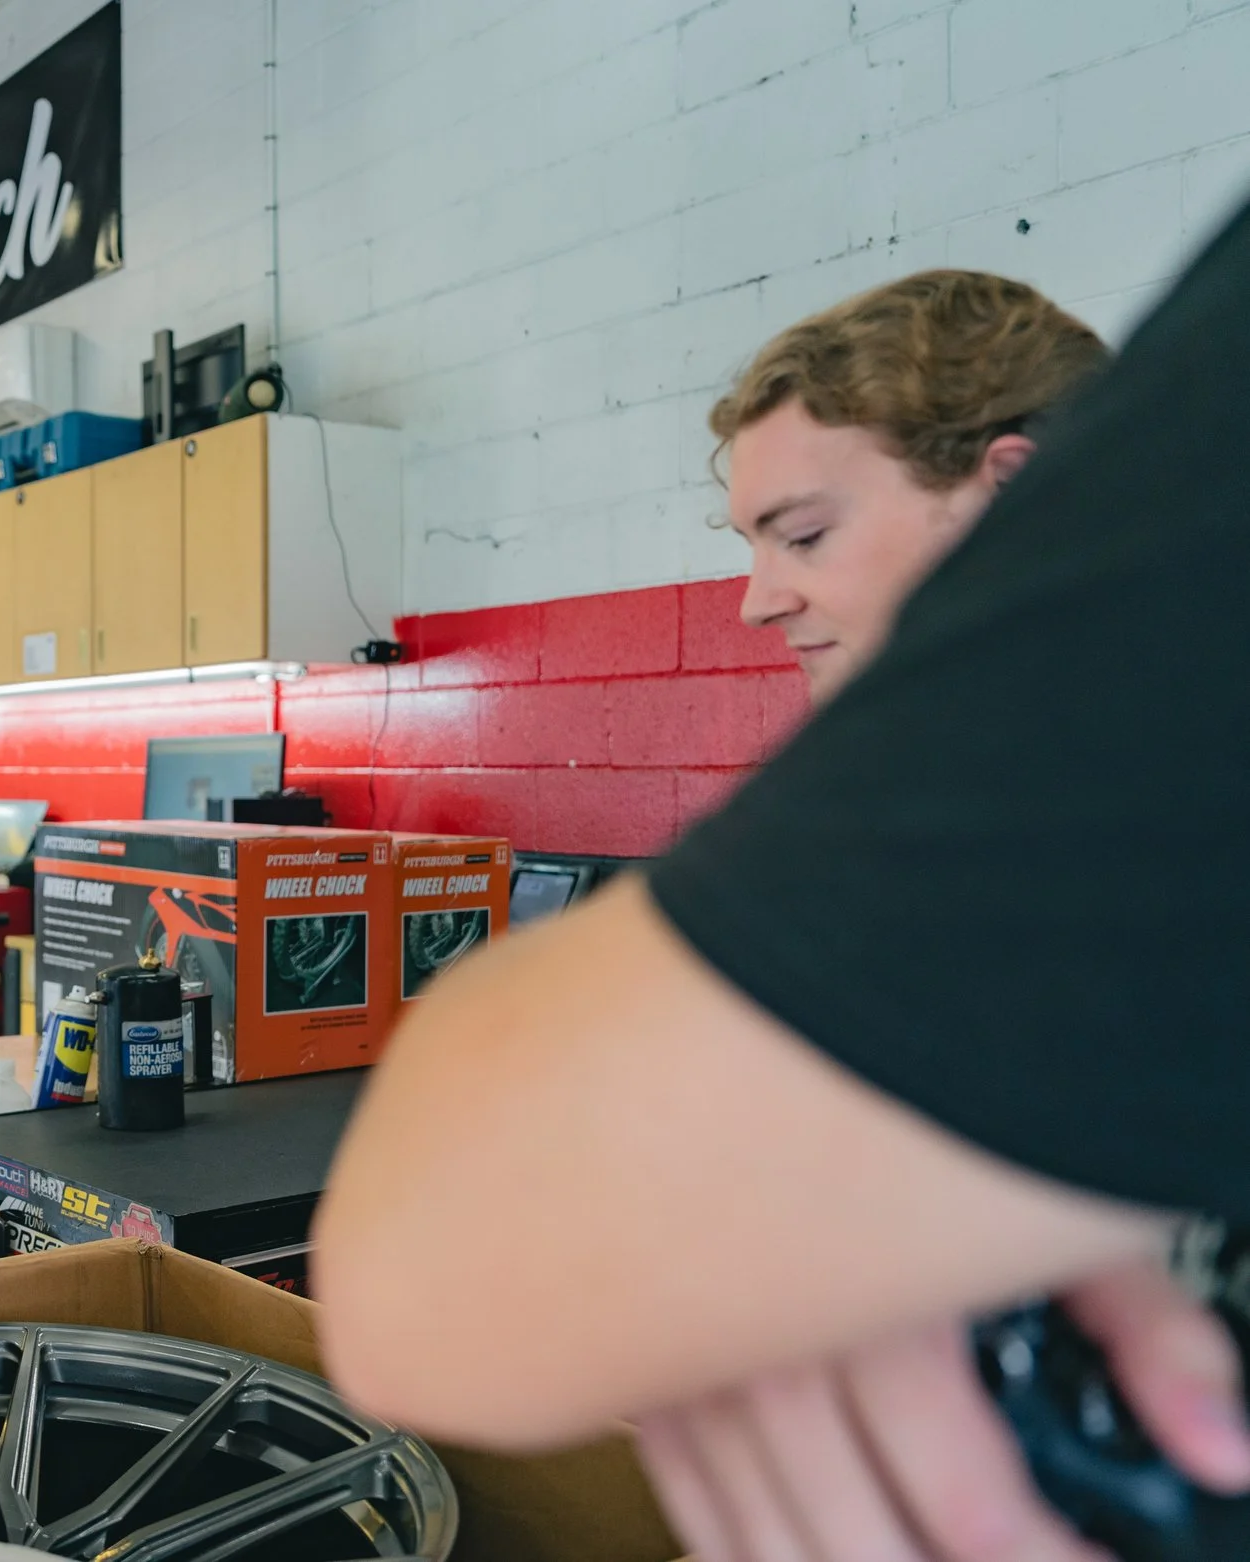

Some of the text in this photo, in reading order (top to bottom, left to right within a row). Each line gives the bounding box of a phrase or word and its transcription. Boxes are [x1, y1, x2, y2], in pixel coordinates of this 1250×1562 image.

[266, 853, 335, 866] PITTSBURGH
[403, 854, 465, 868] PITTSBURGH
[264, 874, 367, 899] WHEEL CHOCK
[402, 873, 490, 897] WHEEL CHOCK
[64, 1026, 96, 1051] WD-
[129, 1041, 179, 1055] REFILLABLE
[129, 1064, 172, 1076] SPRAYER
[25, 1203, 44, 1219] AWE
[7, 1225, 61, 1253] PRE
